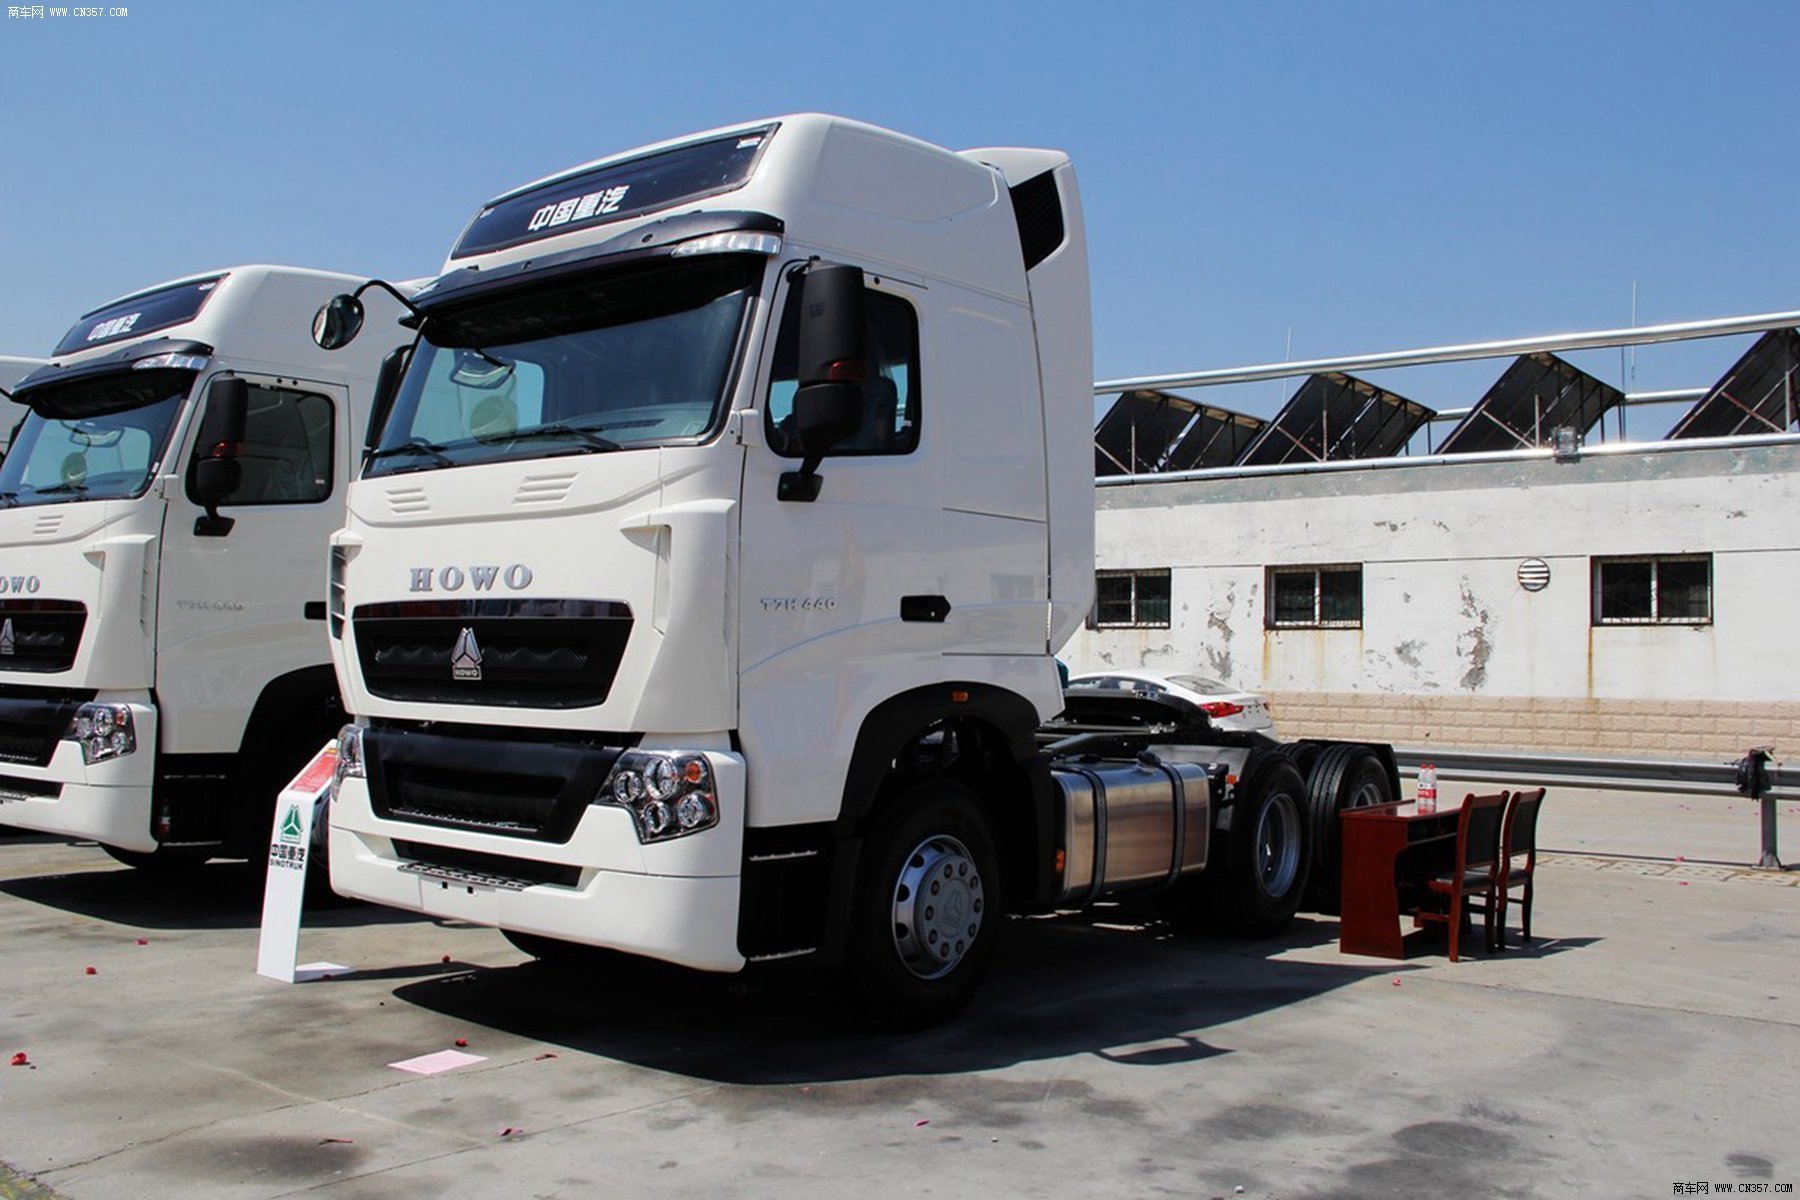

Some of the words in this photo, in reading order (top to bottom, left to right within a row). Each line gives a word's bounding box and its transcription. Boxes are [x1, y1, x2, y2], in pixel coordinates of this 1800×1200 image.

[528, 185, 630, 231] 中国重汽
[409, 564, 533, 592] HOWO
